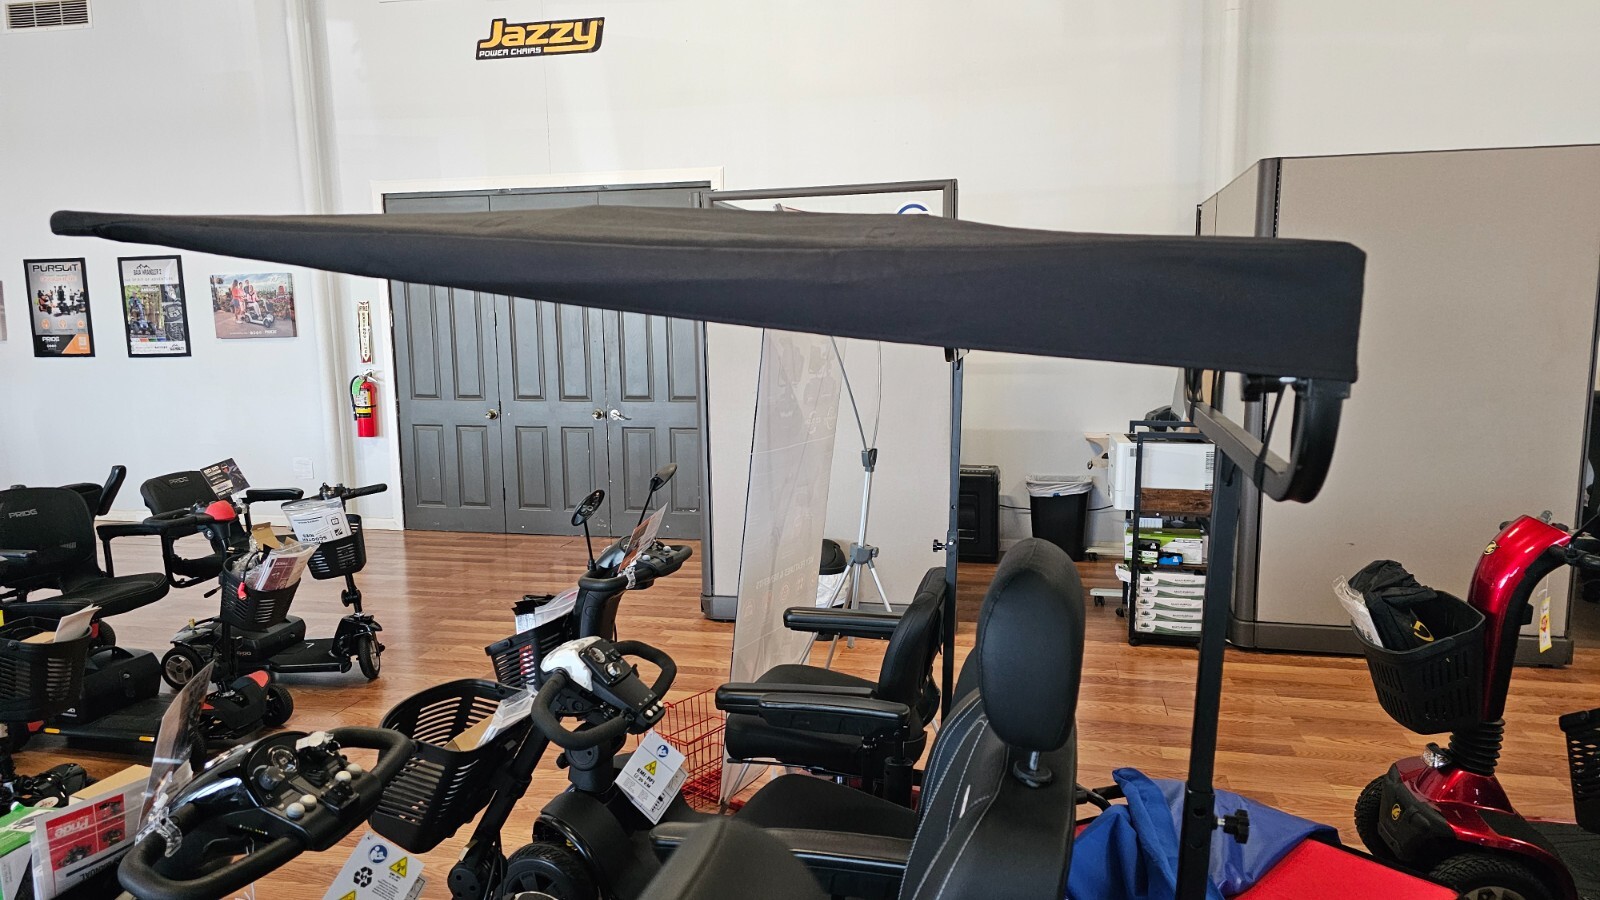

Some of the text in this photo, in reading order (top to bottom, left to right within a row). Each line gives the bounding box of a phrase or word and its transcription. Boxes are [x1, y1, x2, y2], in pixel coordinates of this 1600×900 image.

[479, 20, 598, 53] Jazzy
[479, 47, 542, 57] POWER CHAIRS
[32, 263, 78, 272] PURSUIT
[8, 508, 38, 519] PRIDE
[55, 815, 89, 839] Pride
